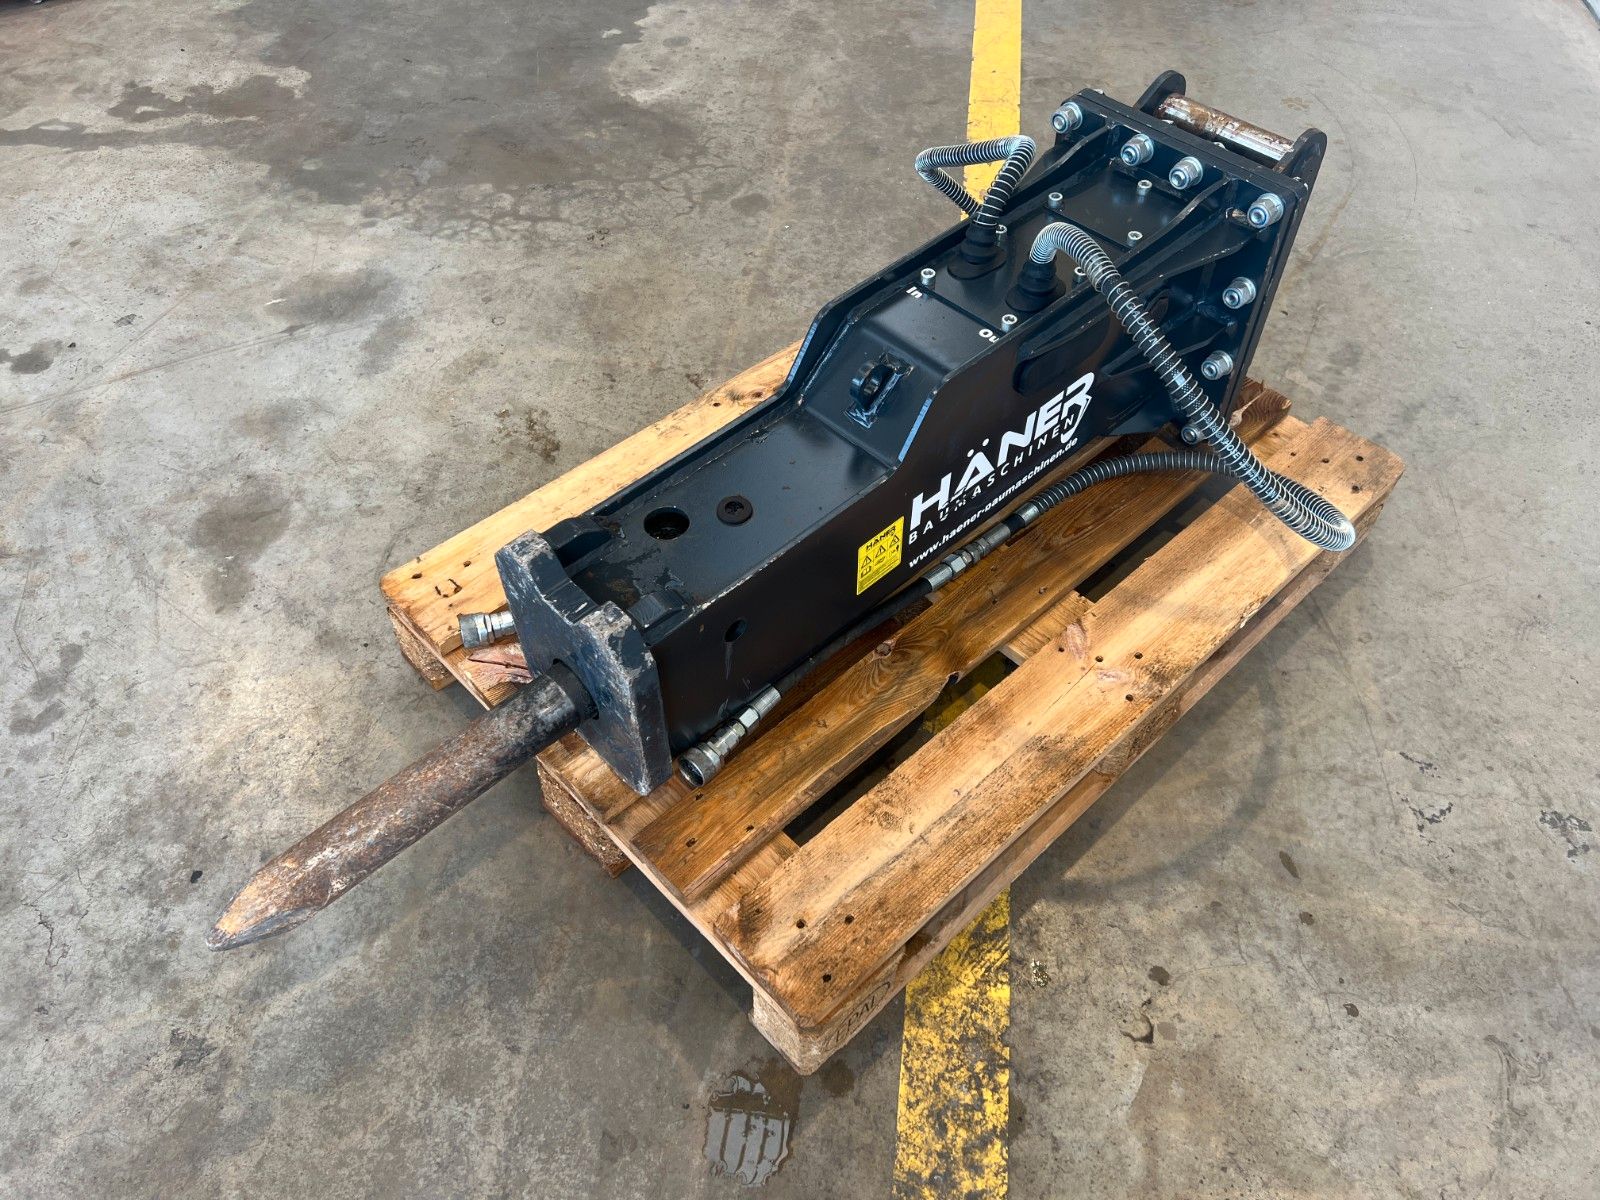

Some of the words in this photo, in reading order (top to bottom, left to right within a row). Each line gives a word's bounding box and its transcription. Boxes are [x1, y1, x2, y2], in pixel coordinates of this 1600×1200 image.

[905, 286, 923, 299] In
[908, 413, 1075, 545] BAUMASCHINEN
[910, 371, 1096, 531] HÄNER
